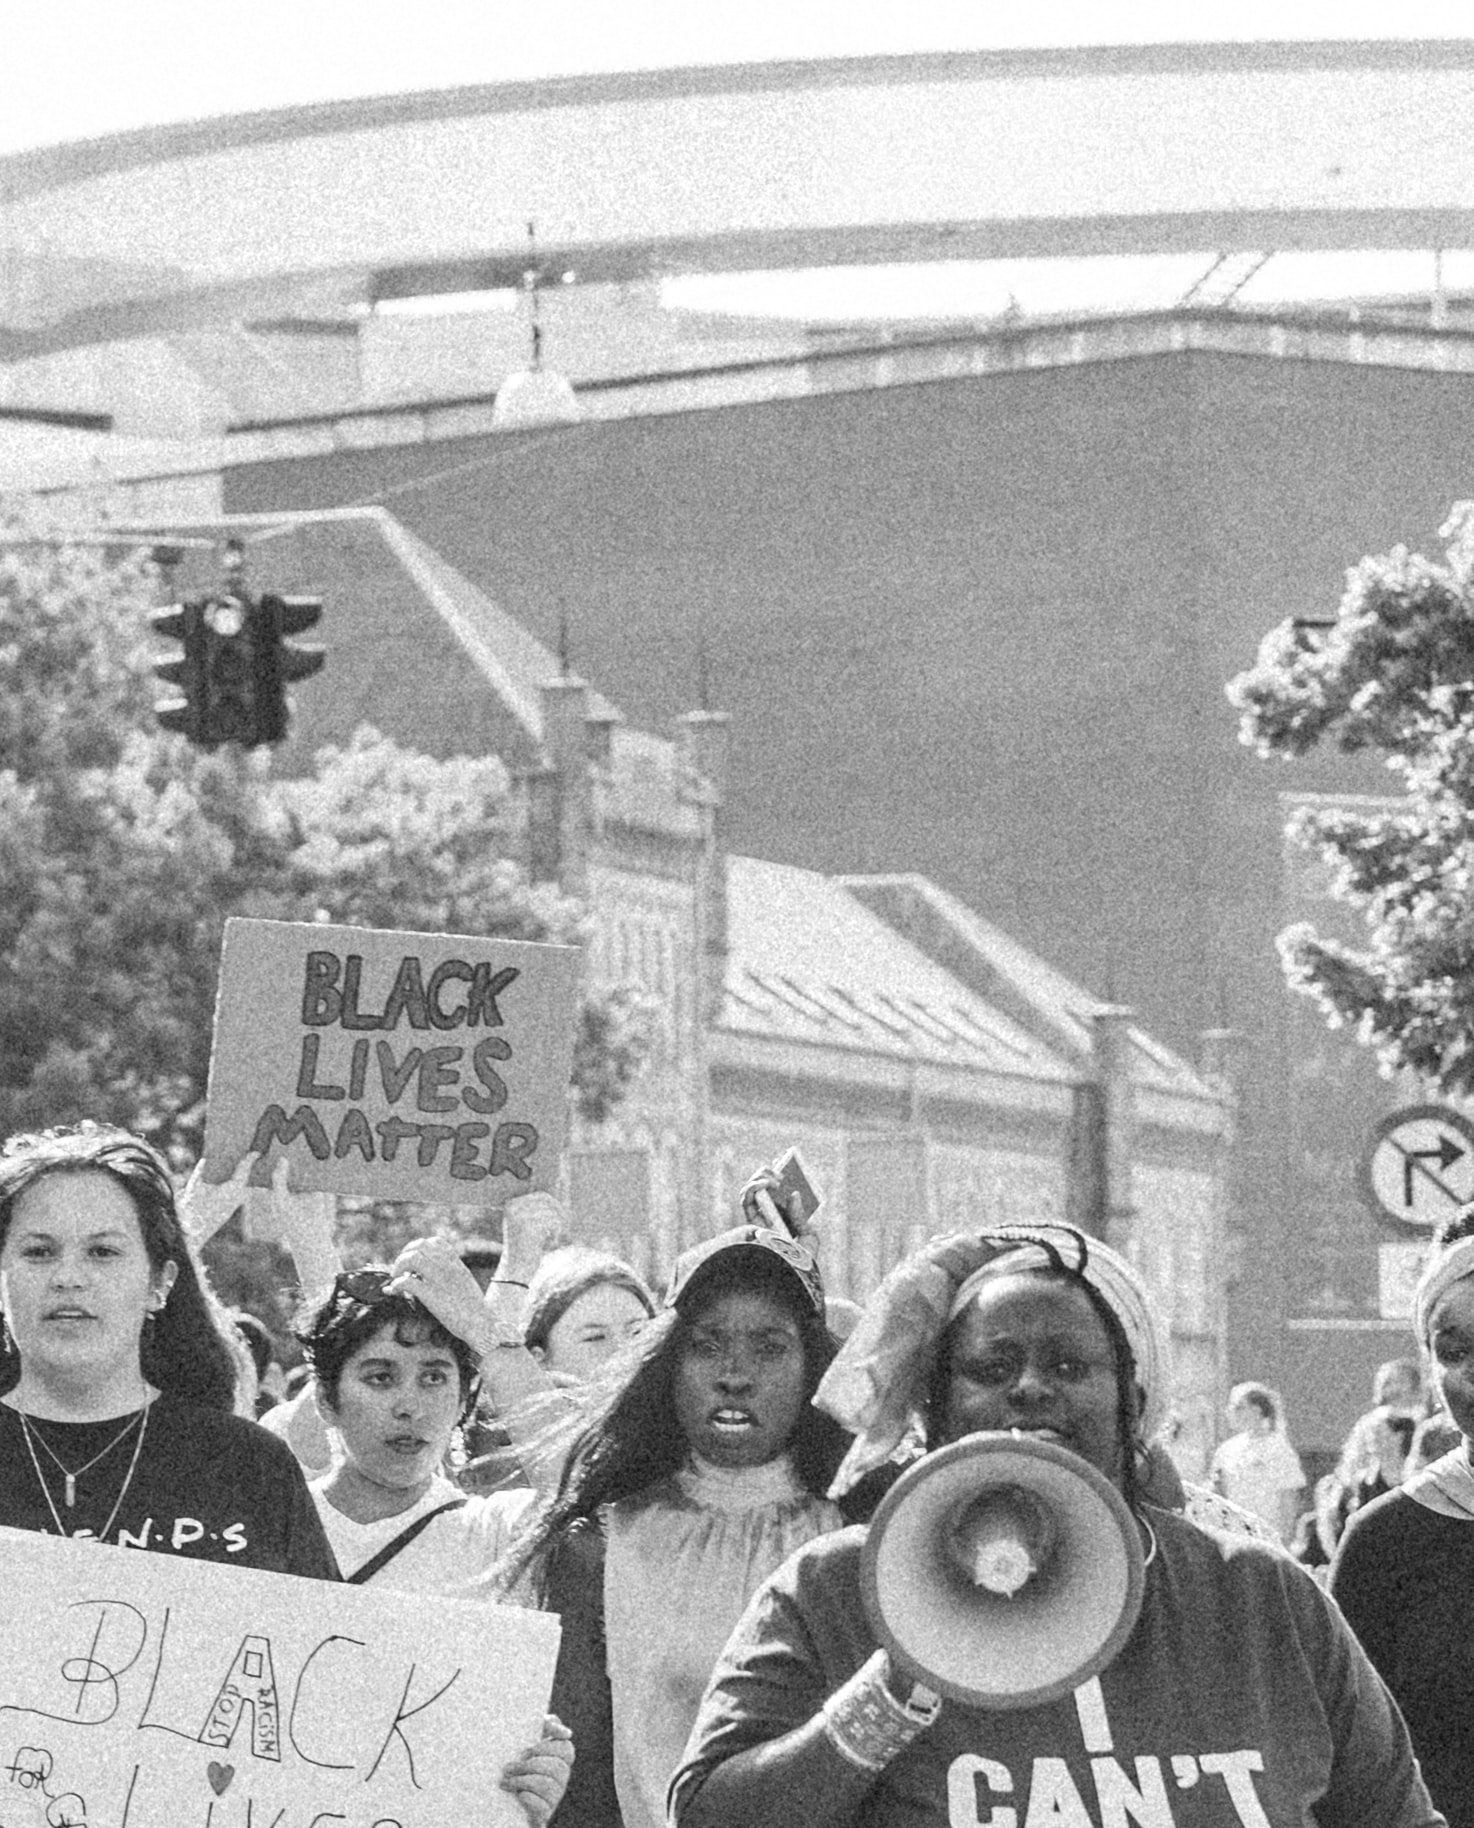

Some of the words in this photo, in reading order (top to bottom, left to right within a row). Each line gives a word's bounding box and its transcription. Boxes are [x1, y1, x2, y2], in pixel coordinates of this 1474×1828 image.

[301, 951, 521, 1030] BLACK
[296, 1034, 513, 1114] LIVES
[253, 1103, 540, 1181] MATTER
[207, 1683, 244, 1750] STOP
[1073, 1674, 1114, 1754] I
